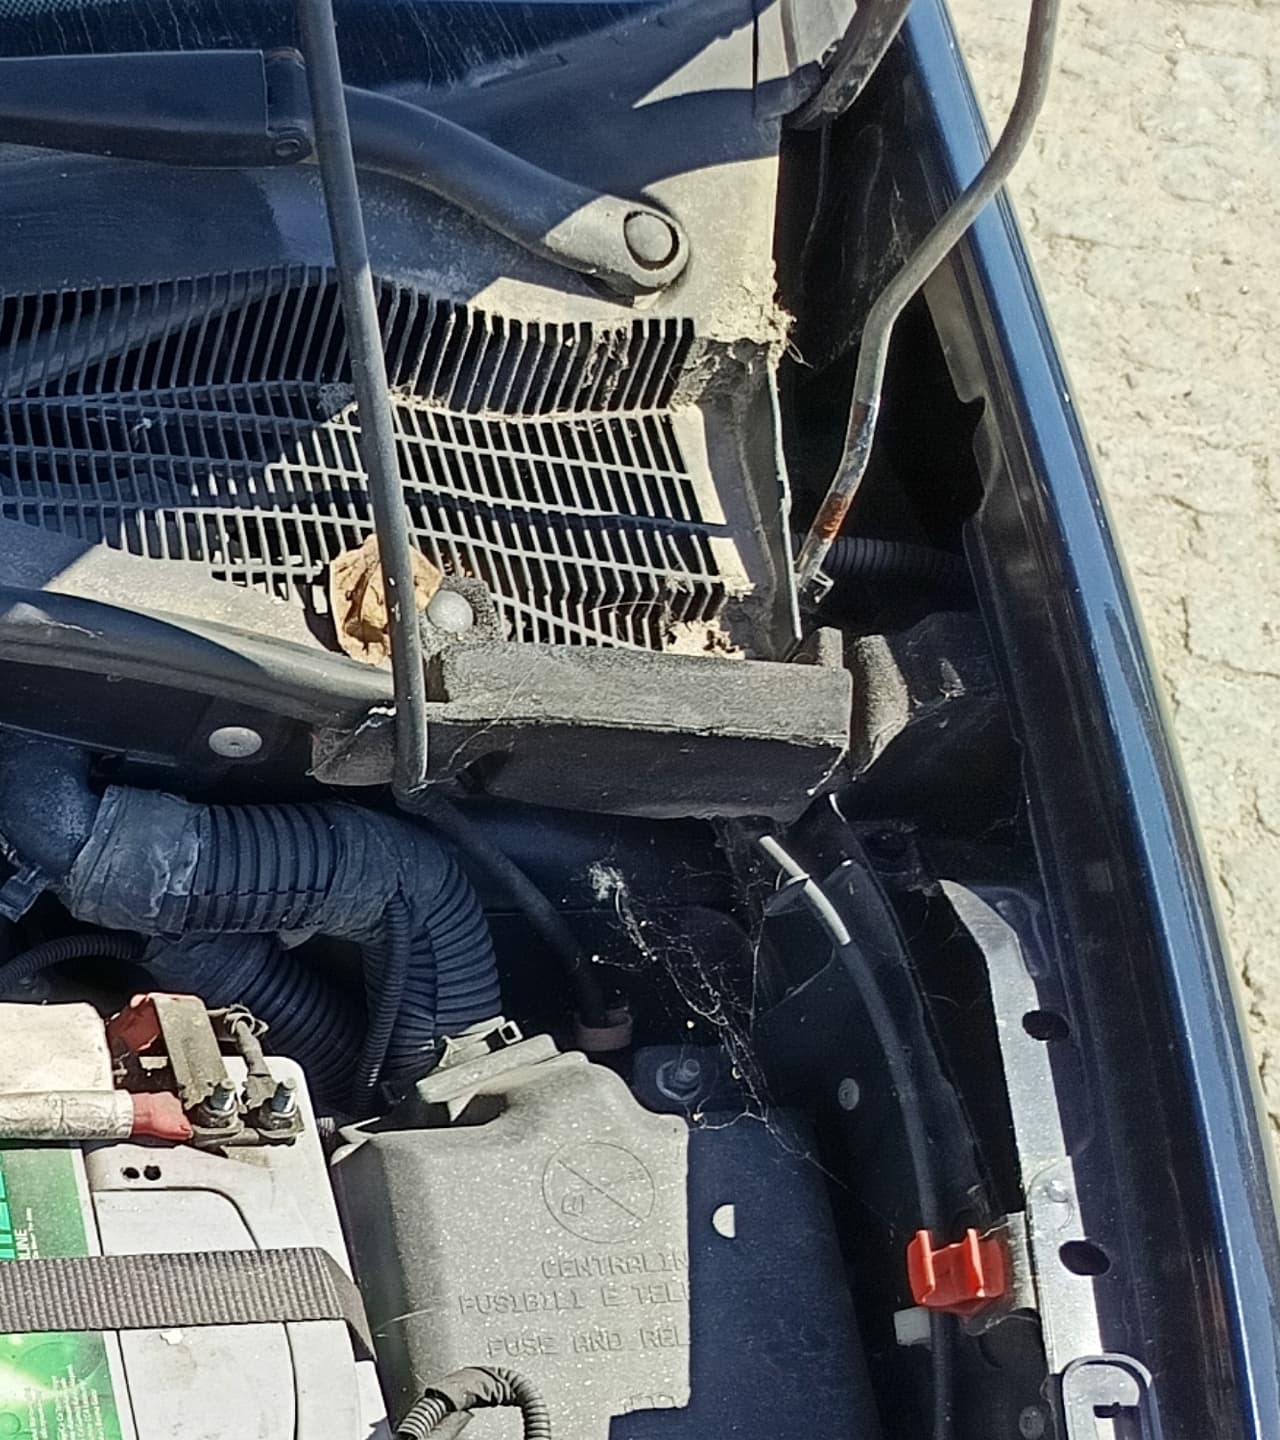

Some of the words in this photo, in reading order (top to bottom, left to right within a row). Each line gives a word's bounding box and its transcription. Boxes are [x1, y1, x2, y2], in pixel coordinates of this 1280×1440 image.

[541, 1251, 689, 1279] CENTRALIN
[458, 1288, 585, 1316] FUSIBILI
[600, 1285, 627, 1307] E
[487, 1333, 559, 1359] FUSE
[572, 1329, 623, 1354] AND
[640, 1326, 690, 1349] REL
